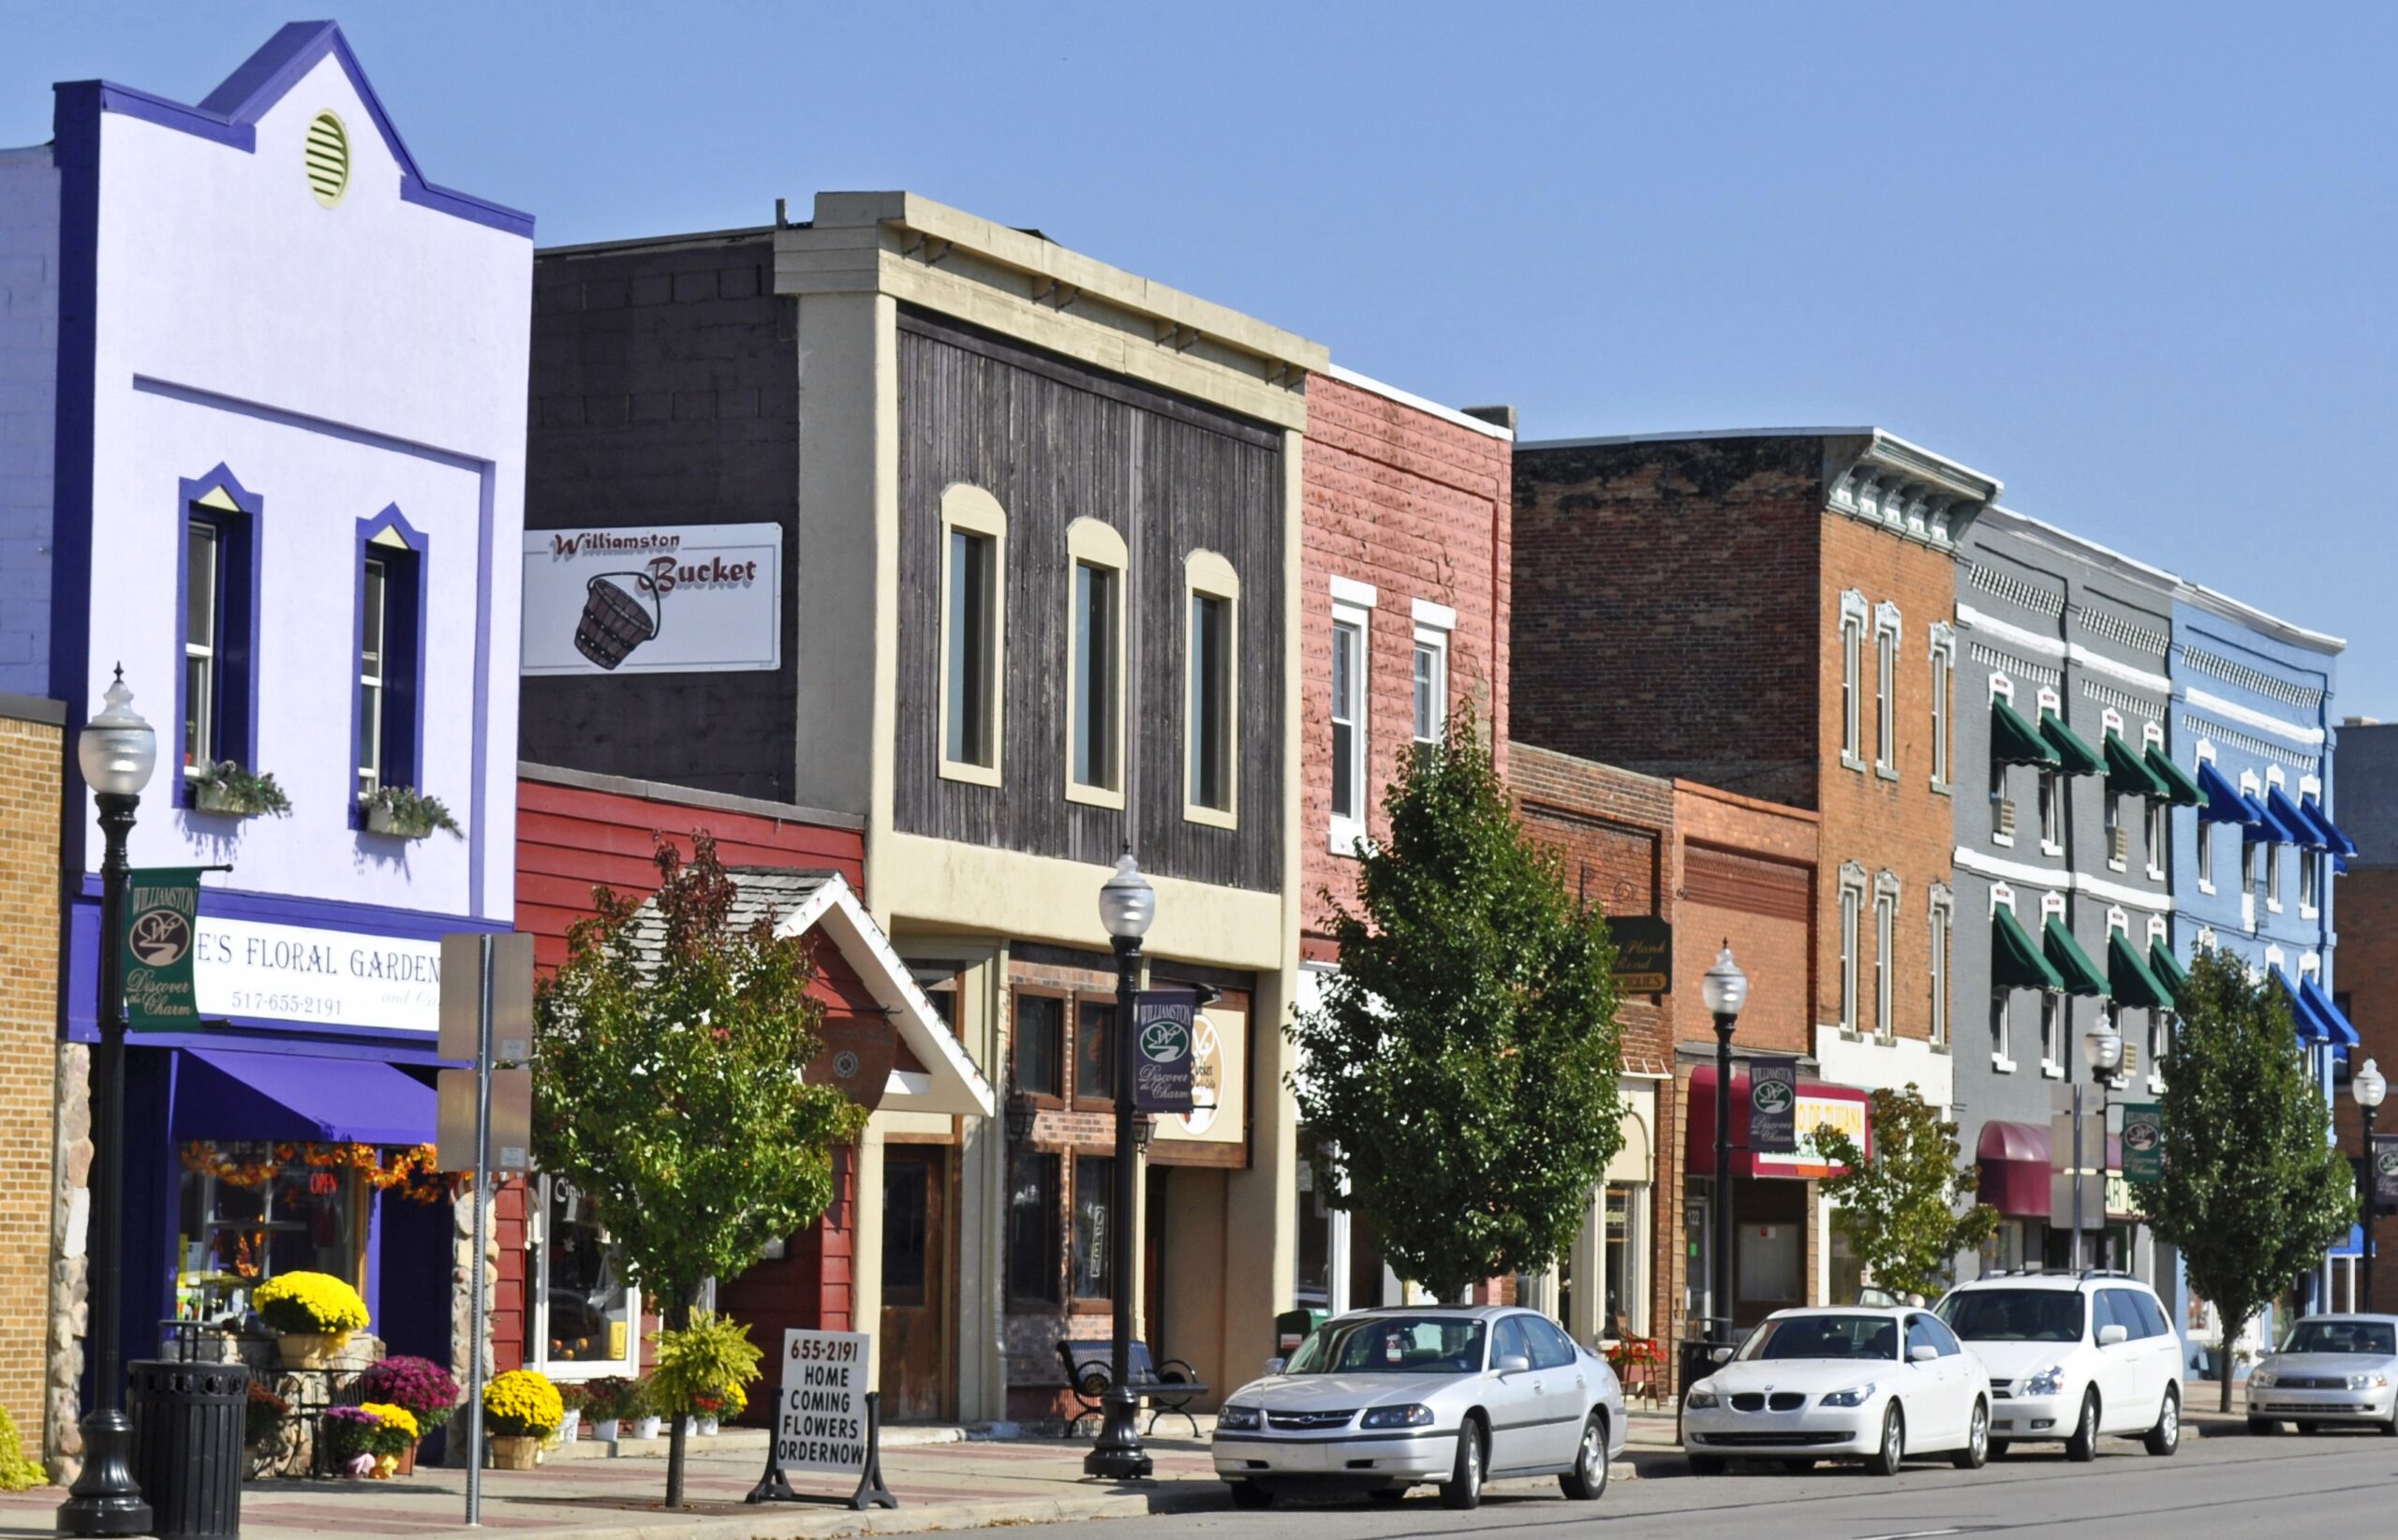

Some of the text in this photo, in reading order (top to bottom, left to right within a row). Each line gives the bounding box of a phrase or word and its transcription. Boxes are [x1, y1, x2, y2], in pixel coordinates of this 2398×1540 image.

[554, 532, 680, 556] Williamston
[638, 555, 757, 593] Bucket
[132, 886, 198, 917] WILLIAMSTON
[247, 938, 337, 975] FLORAL
[350, 949, 440, 984] GARDEN
[126, 968, 190, 994] Discover
[141, 991, 193, 1015] Charm
[232, 991, 341, 1016] 517-655-2191
[381, 988, 440, 1008] and Ca
[1140, 1004, 1192, 1028] WILLIAMSTON
[1139, 1064, 1188, 1083] Discover
[1752, 1067, 1795, 1086] WILLIAMSTON
[1151, 1081, 1190, 1099] Charm
[310, 1173, 338, 1195] OPEN
[791, 1339, 858, 1362] 655-2191
[805, 1365, 850, 1387] HOME
[791, 1389, 851, 1414] COMING
[783, 1414, 858, 1440] FLOWERS
